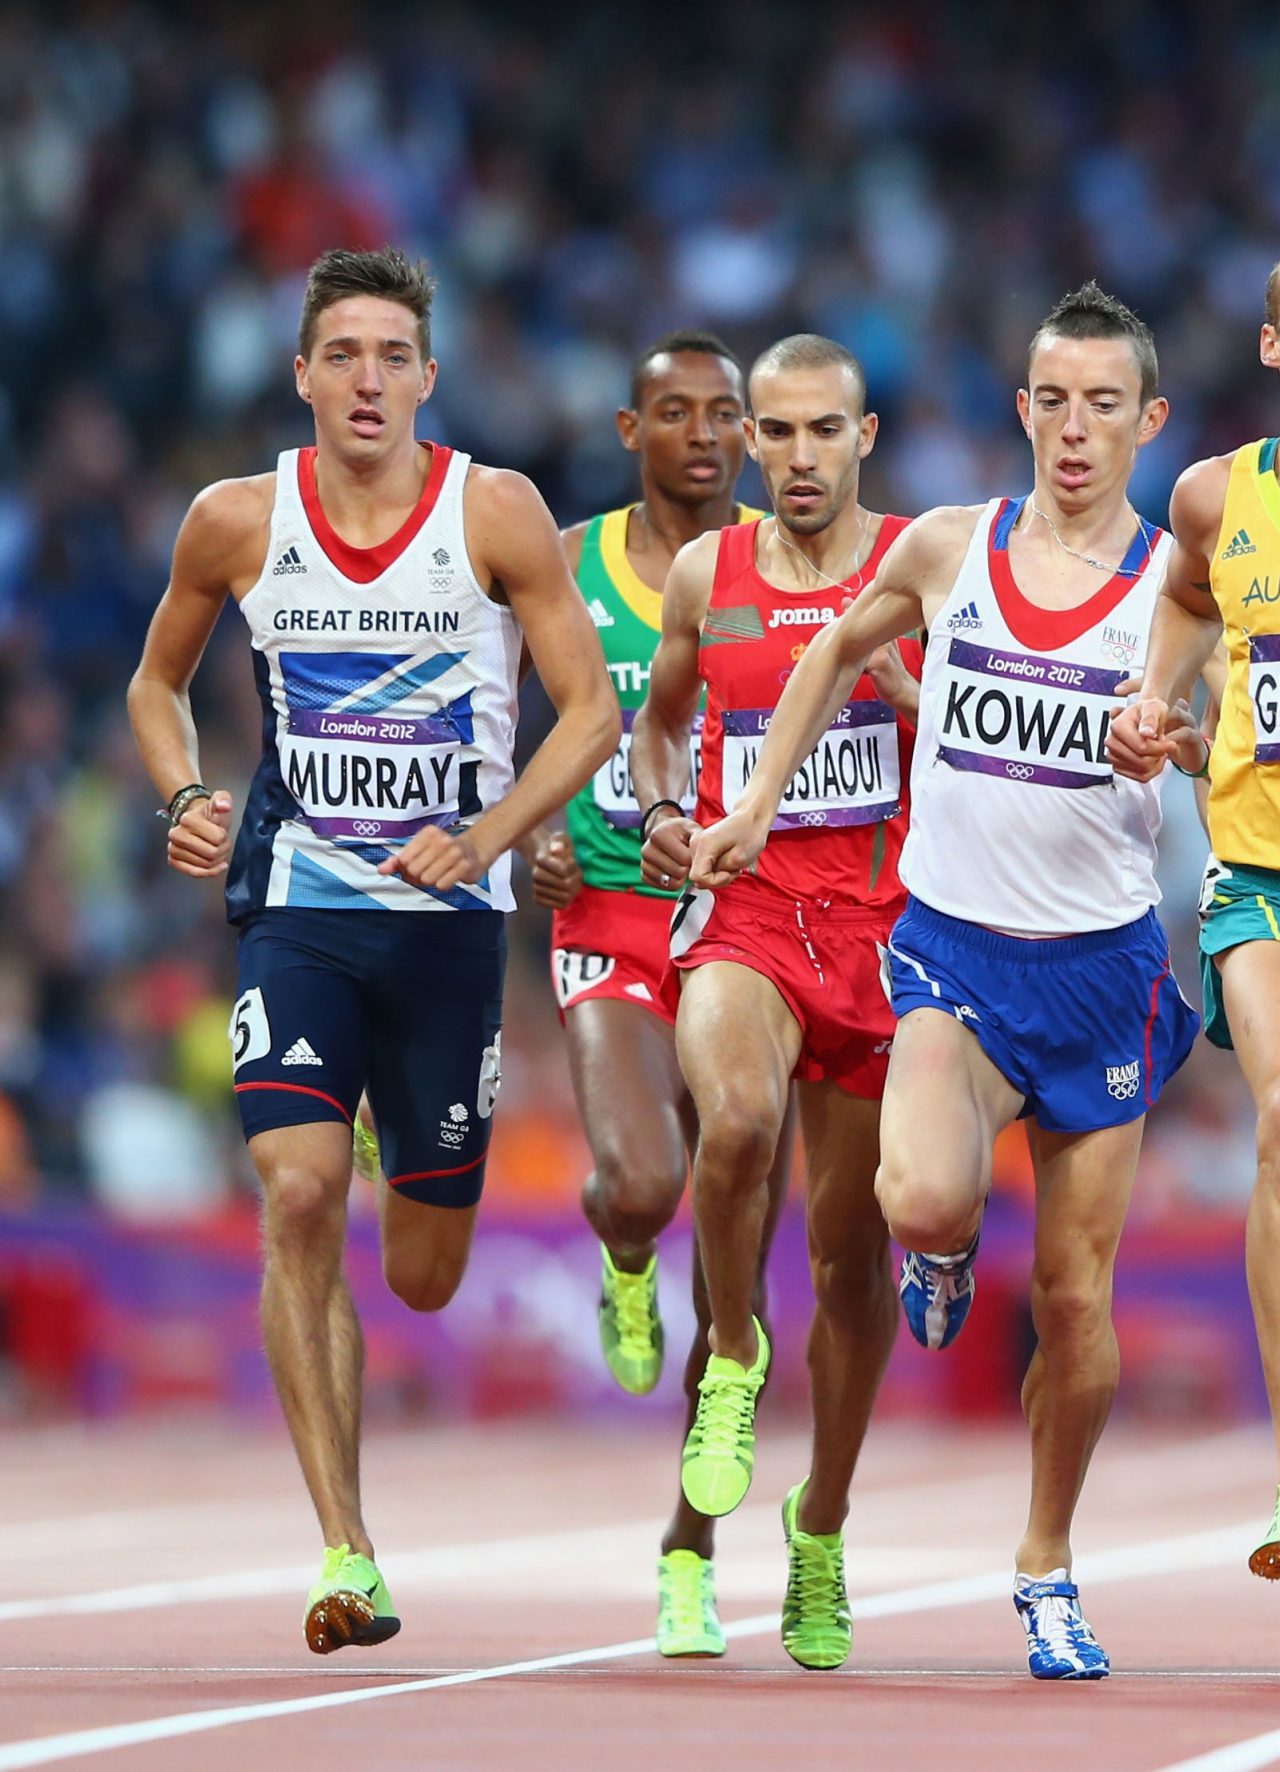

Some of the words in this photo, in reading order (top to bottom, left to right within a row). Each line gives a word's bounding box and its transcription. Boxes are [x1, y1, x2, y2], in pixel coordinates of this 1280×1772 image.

[1221, 542, 1257, 560] adidas
[272, 563, 308, 576] adidas
[273, 609, 352, 631] GREAT
[359, 610, 460, 633] BRITAIN
[947, 617, 983, 630] adidas
[1102, 626, 1140, 648] FRANCE
[986, 654, 1045, 679] London
[1047, 665, 1086, 686] 2012
[320, 717, 377, 737] London
[379, 723, 416, 739] 2012
[288, 748, 454, 810] MURRAY
[281, 1054, 323, 1066] adidas
[1106, 1060, 1139, 1082] FRANCE
